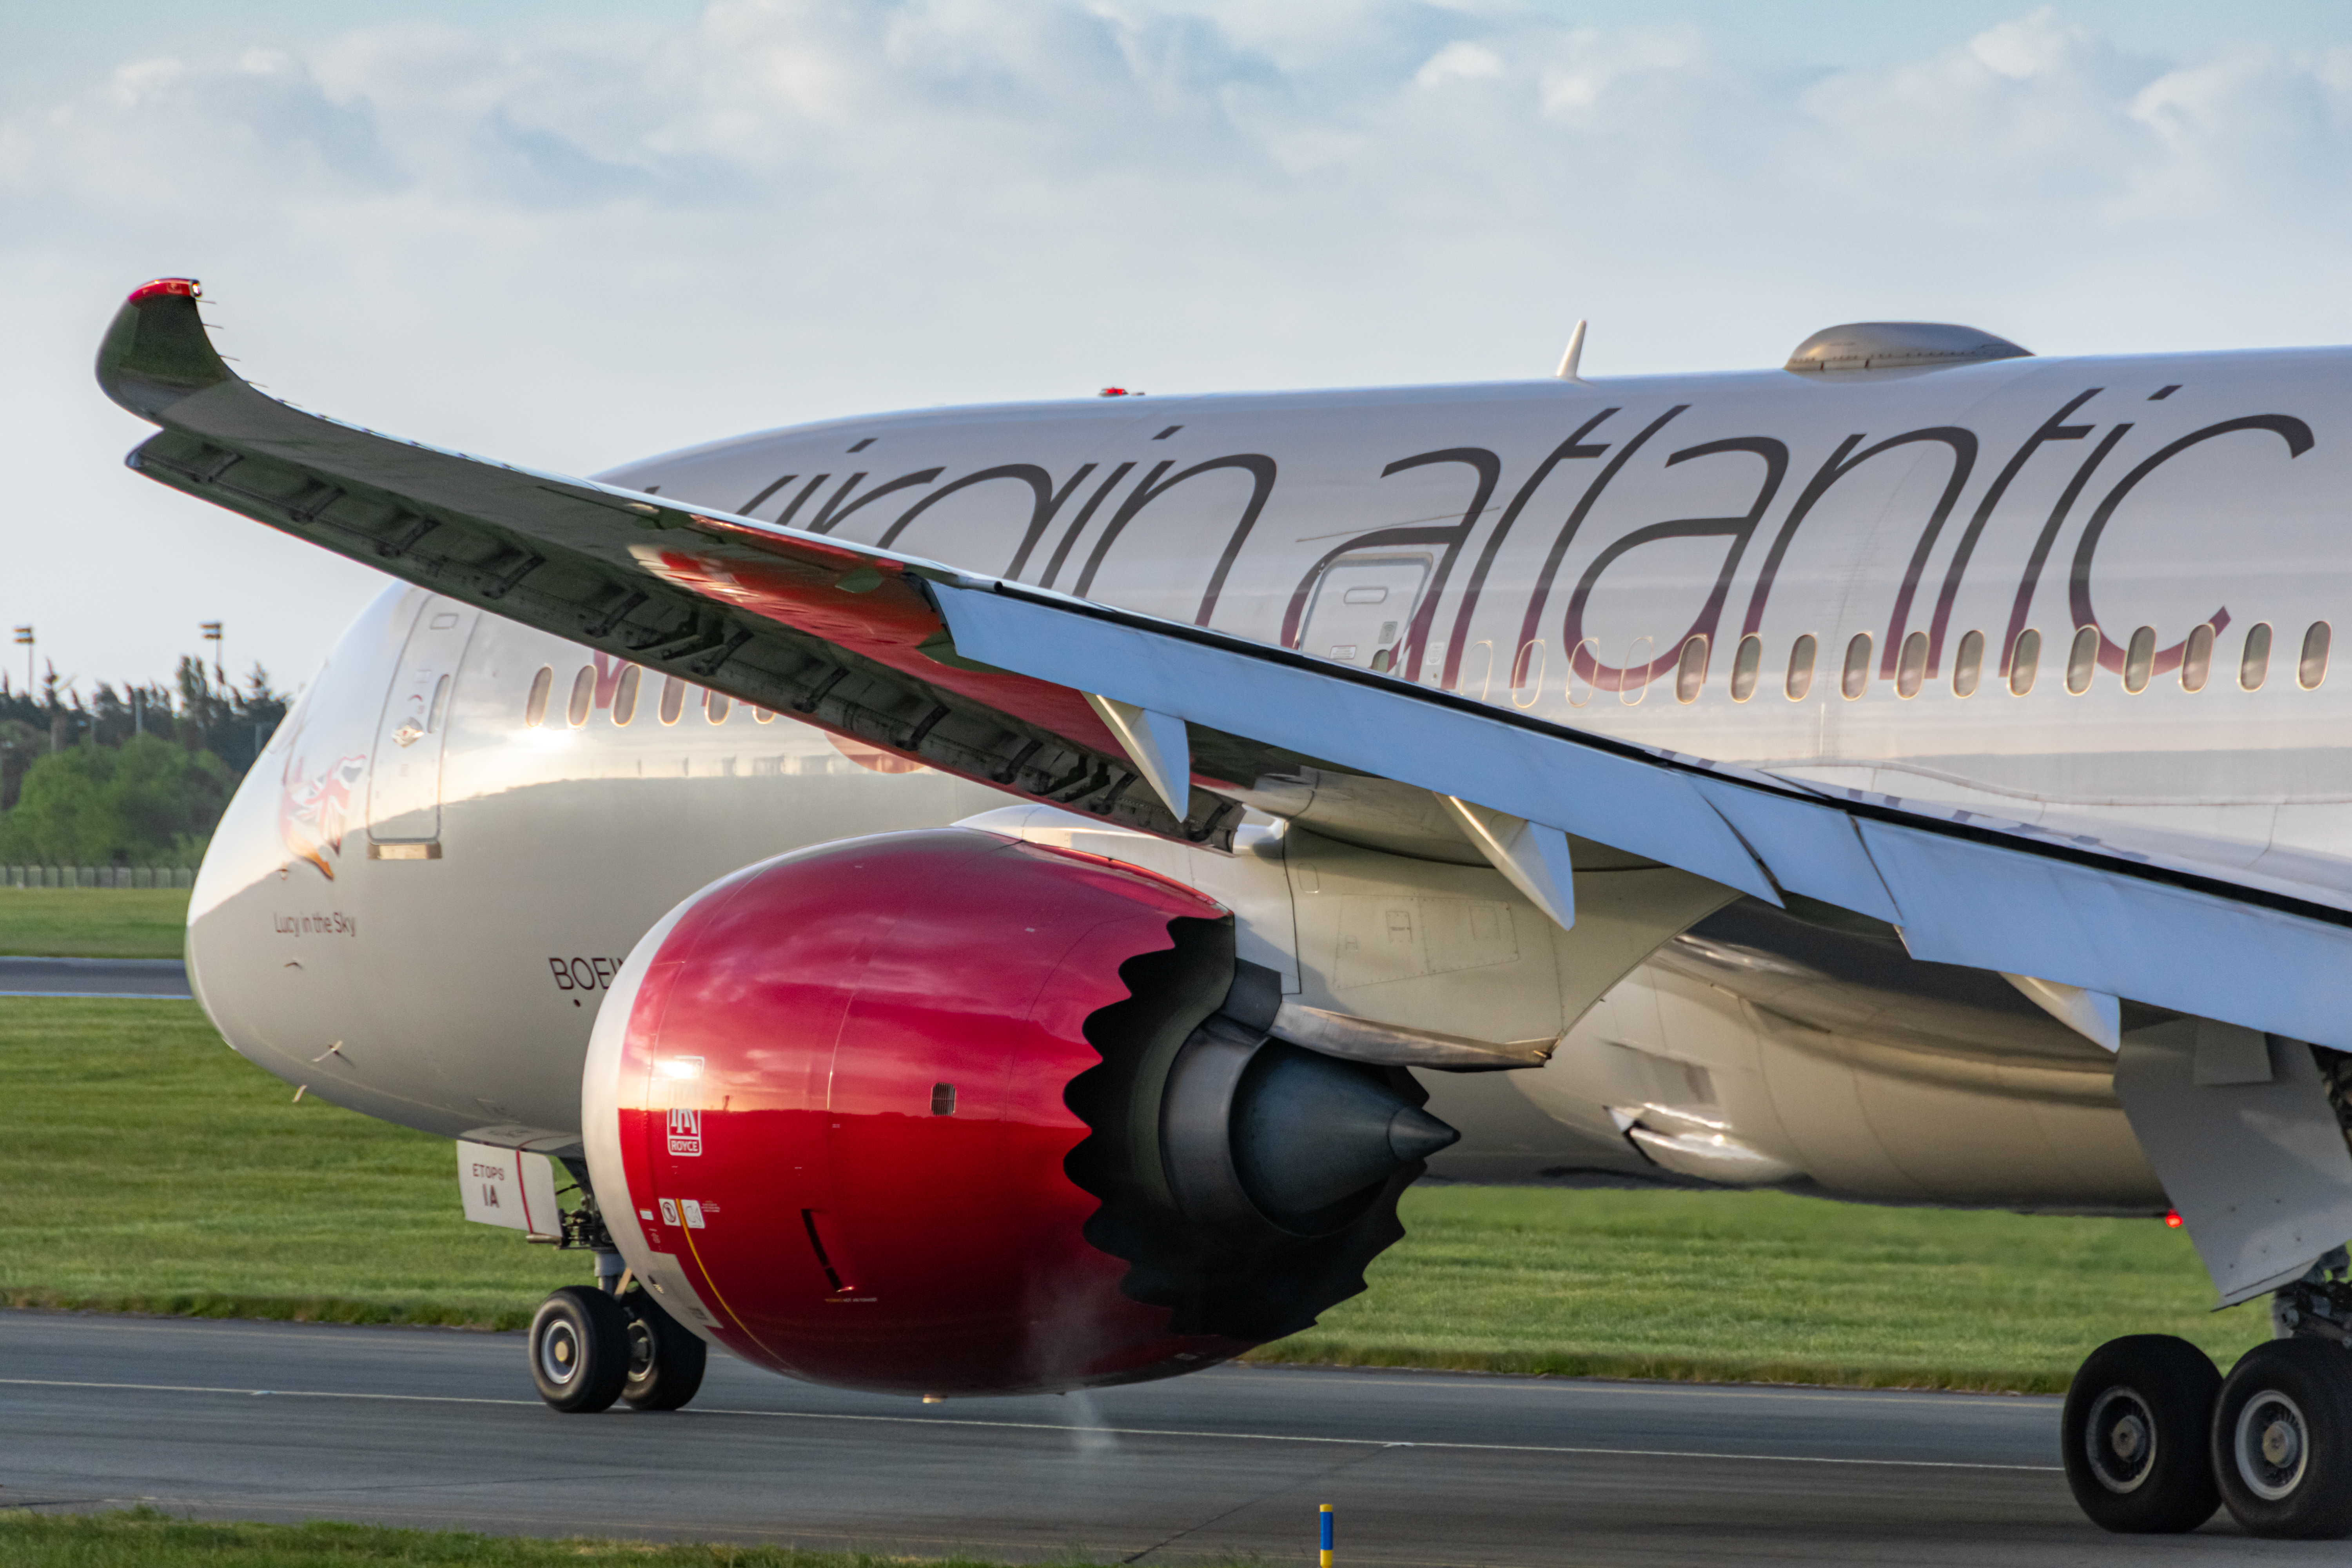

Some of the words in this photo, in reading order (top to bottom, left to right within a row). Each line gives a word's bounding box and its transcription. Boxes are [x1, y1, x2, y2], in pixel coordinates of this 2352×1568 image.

[1280, 385, 2315, 692] atlantic
[274, 912, 300, 937] Lucy
[301, 911, 312, 933] in
[313, 912, 332, 933] the
[333, 911, 355, 937] Sky
[549, 957, 624, 990] BOEI
[671, 1140, 698, 1151] ROYCE
[473, 1163, 504, 1181] ETOPS
